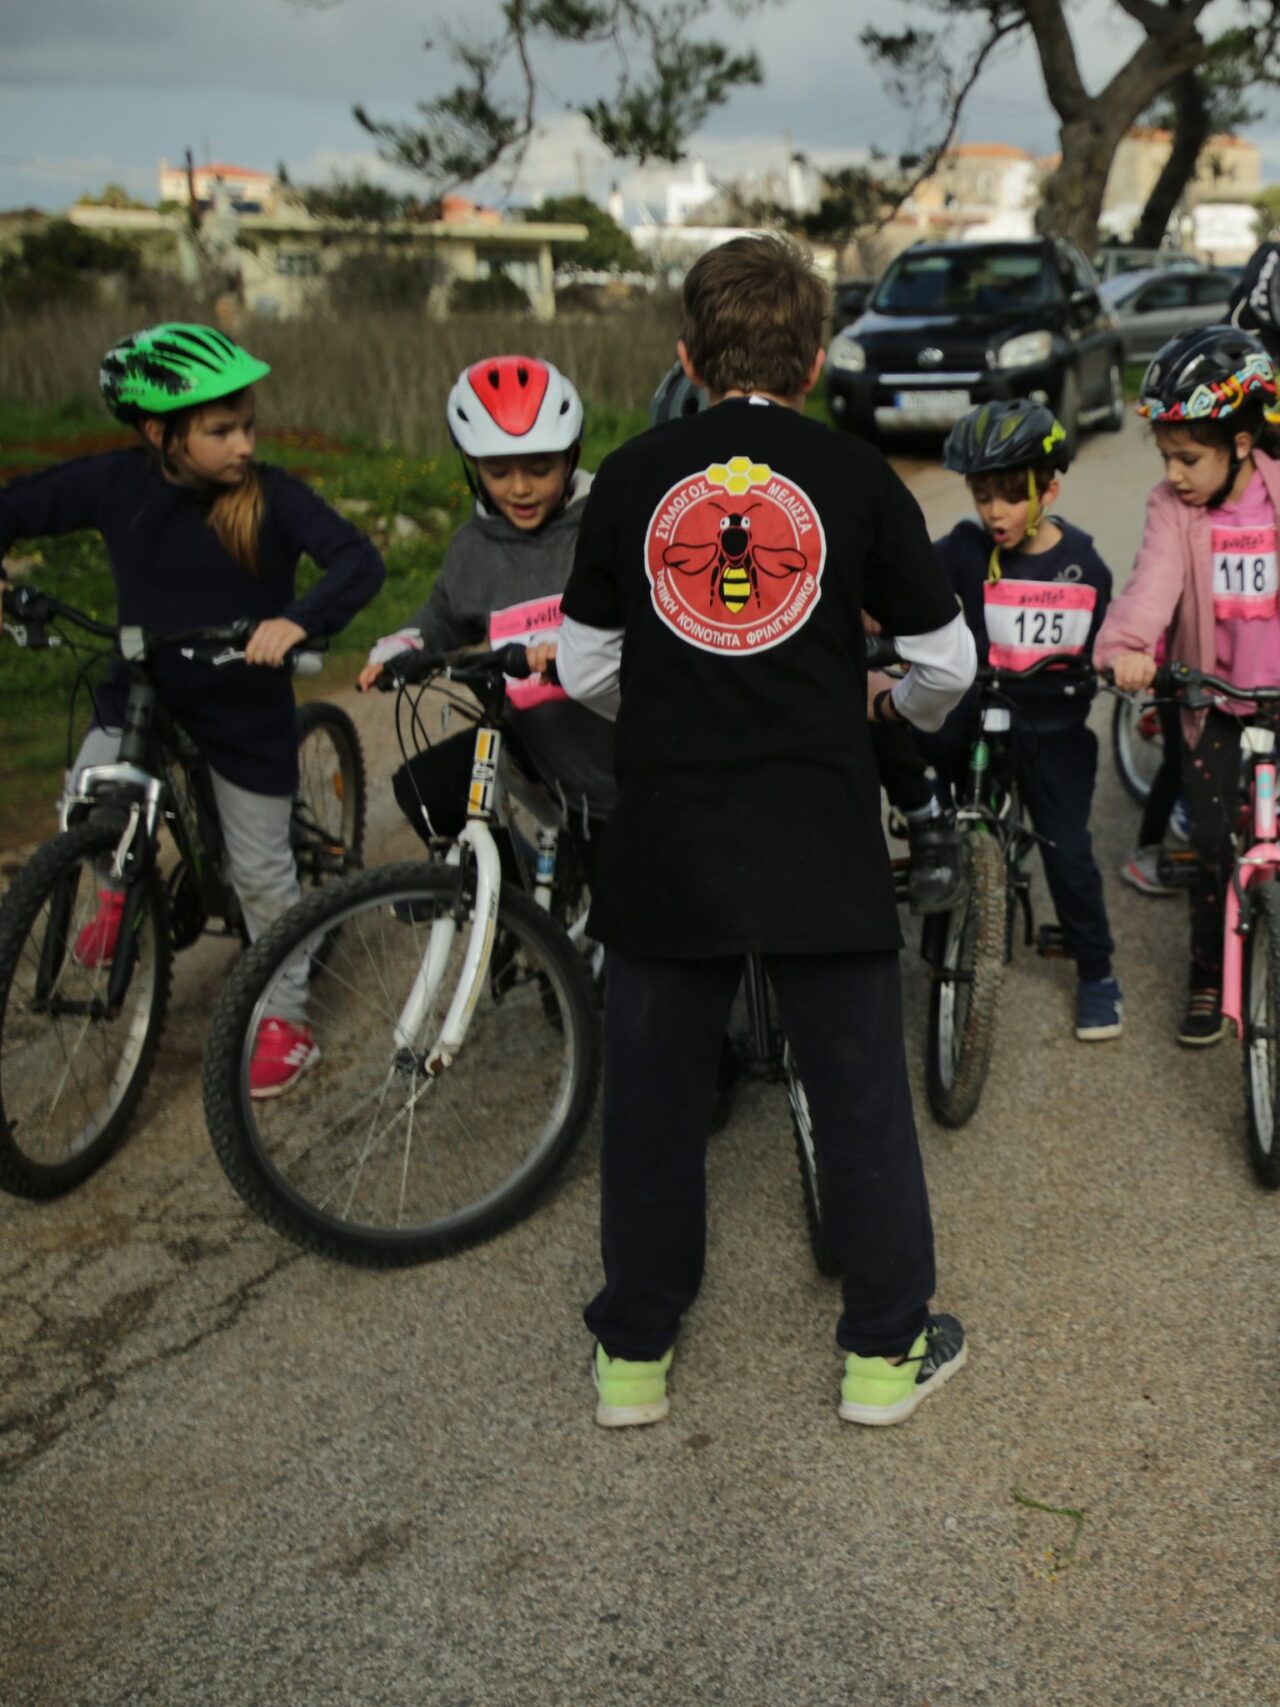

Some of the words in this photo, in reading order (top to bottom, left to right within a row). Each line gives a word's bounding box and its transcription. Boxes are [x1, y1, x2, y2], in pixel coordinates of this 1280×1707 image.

[655, 480, 709, 540] ΣΥΛΛΟΓΟΣ
[767, 482, 813, 535] ΜΕΛΙΣΣΑ
[1220, 556, 1265, 592] 118
[657, 566, 679, 615] ΤΟΠΙΚΗ
[677, 611, 741, 648] ΚΟΙΝΟΤΗΤΑ
[1015, 611, 1064, 645] 125
